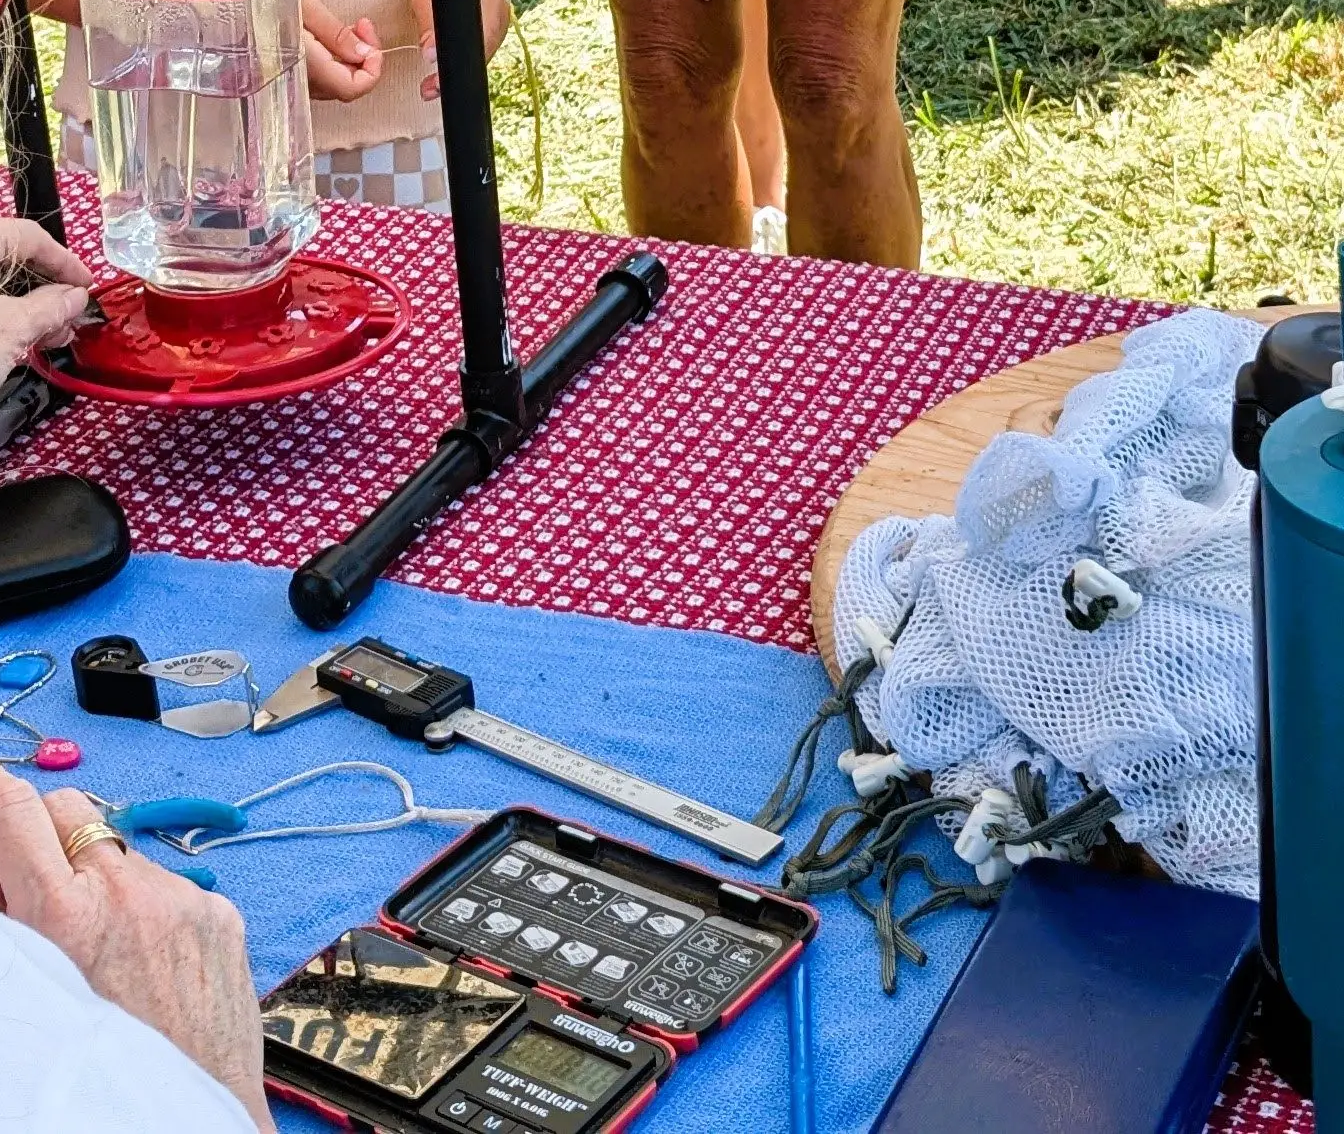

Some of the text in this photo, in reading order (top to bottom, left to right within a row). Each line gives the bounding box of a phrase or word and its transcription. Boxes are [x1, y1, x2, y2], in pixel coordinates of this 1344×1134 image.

[164, 656, 212, 670] GROBET
[542, 852, 567, 865] START
[483, 1116, 503, 1130] M
